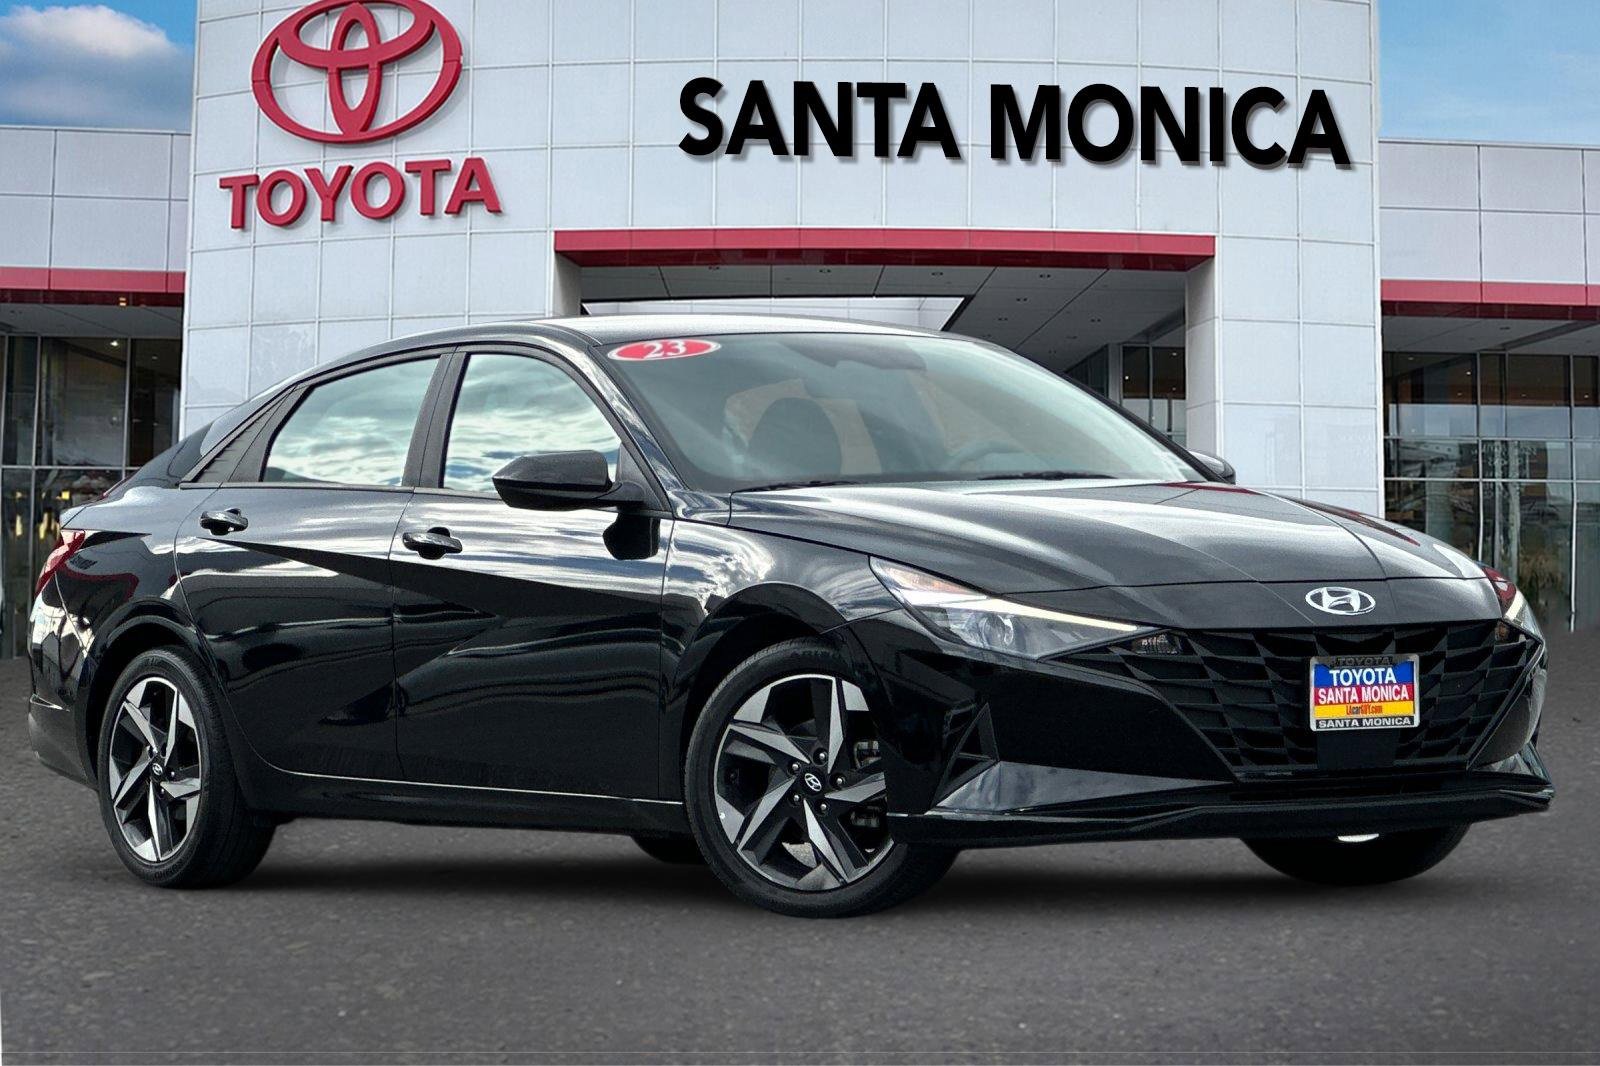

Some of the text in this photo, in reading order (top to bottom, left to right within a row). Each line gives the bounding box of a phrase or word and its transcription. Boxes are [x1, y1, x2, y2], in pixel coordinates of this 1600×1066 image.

[678, 76, 1351, 170] SANTA MONICA
[219, 157, 503, 229] TOYOTA
[641, 339, 688, 359] 23
[1337, 657, 1390, 666] TOYOTA
[1329, 667, 1397, 686] TOYOTA
[1318, 684, 1410, 705] SANTA MONICA
[1318, 716, 1412, 729] SANTA MONICA
